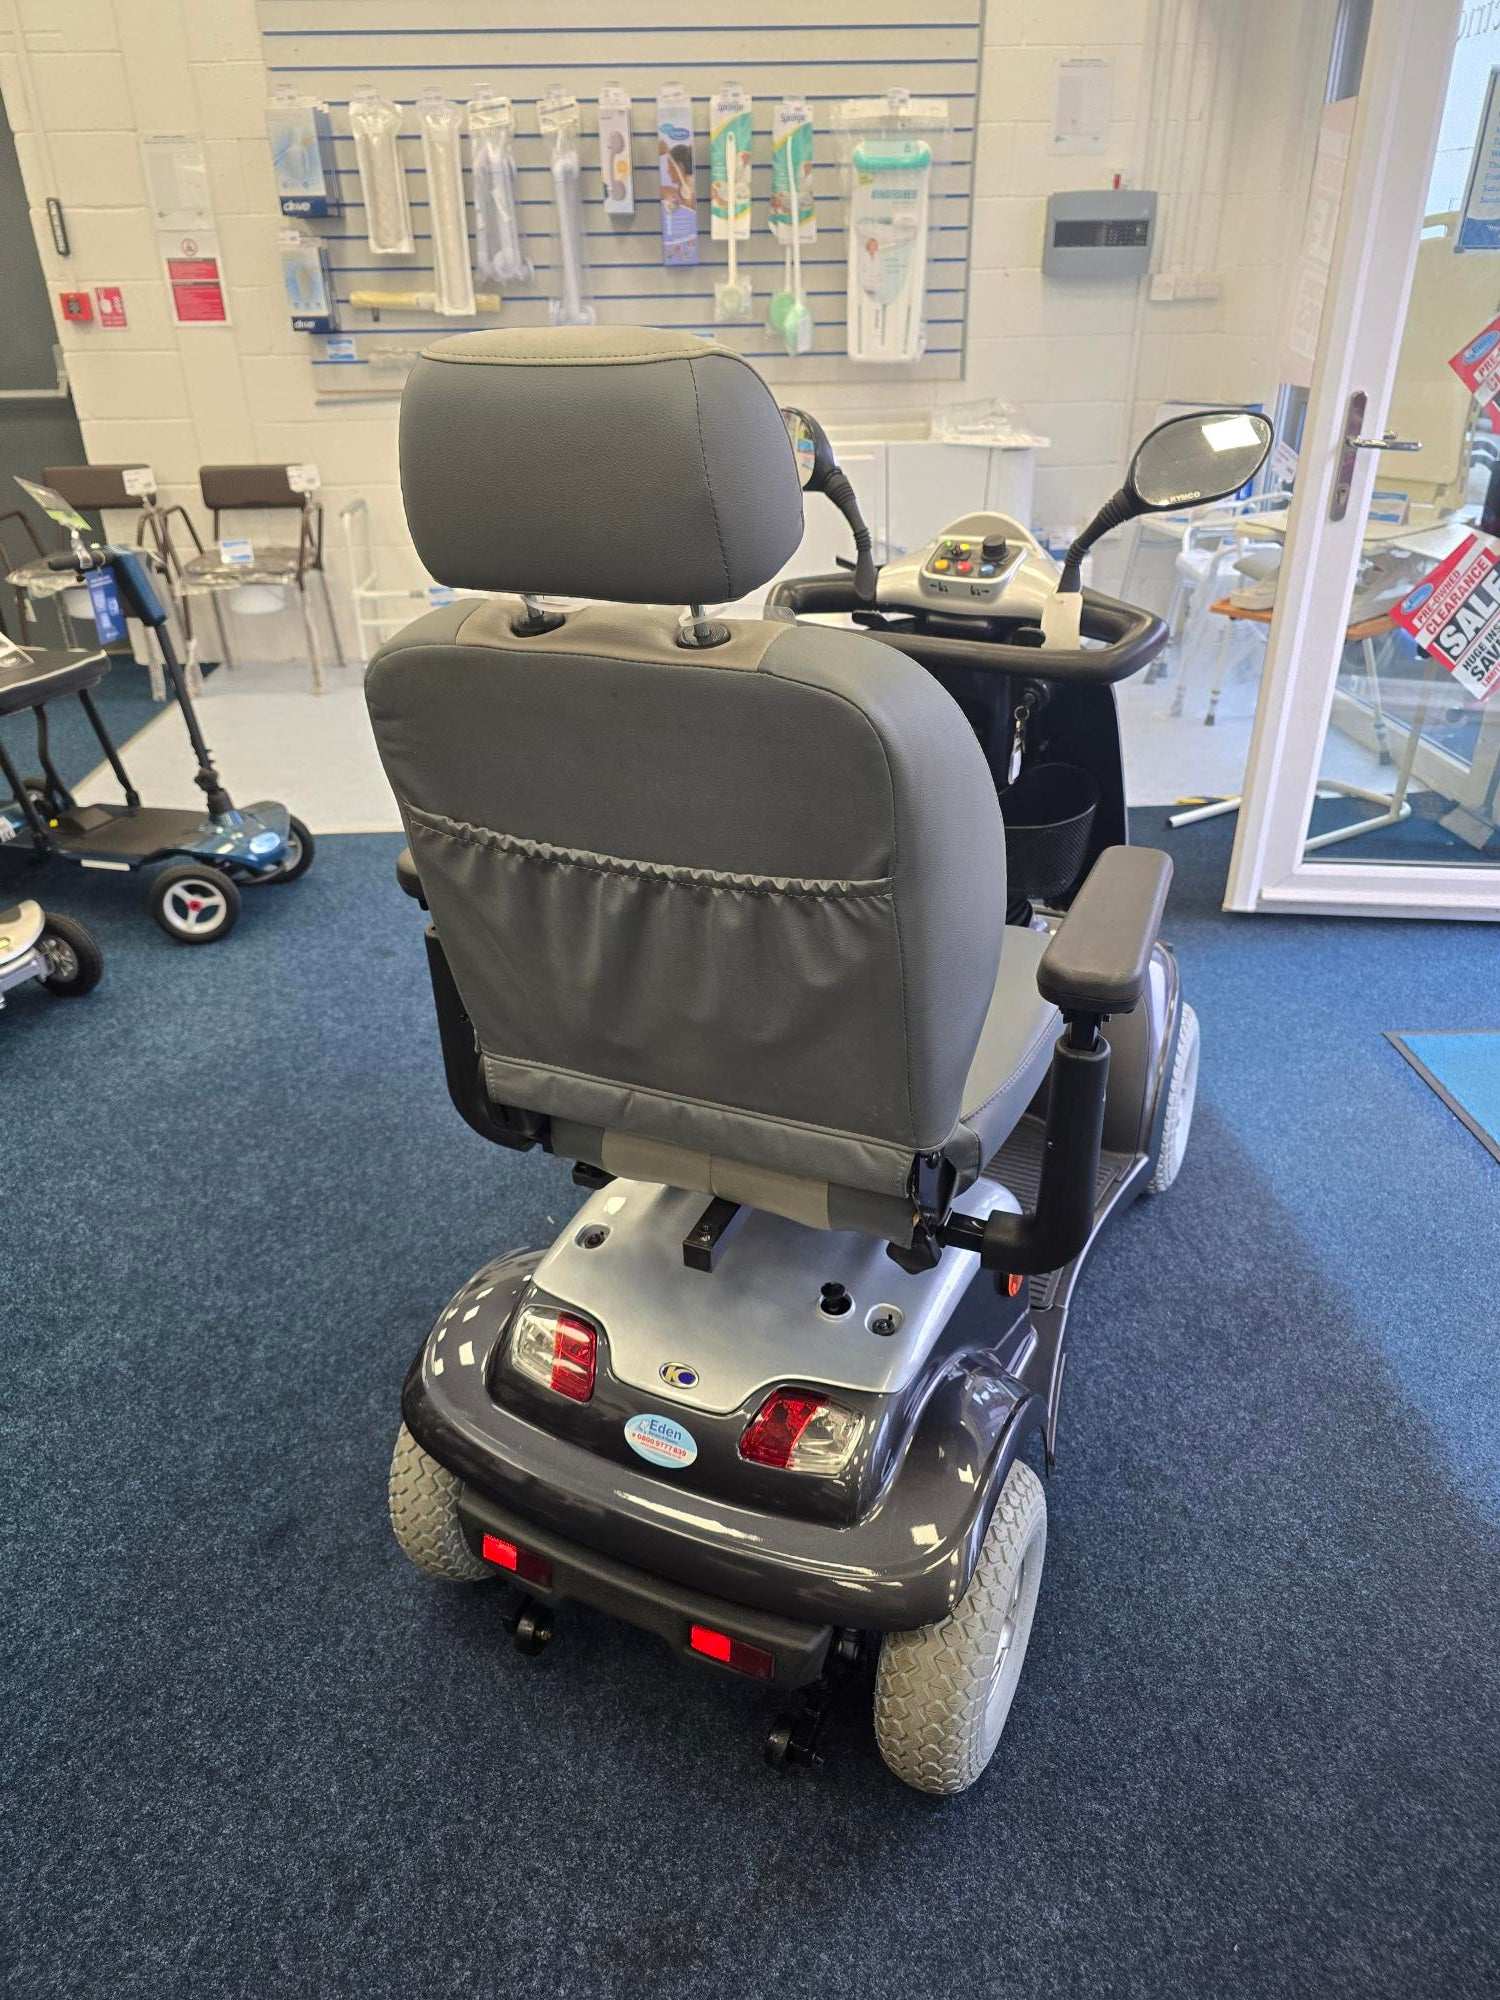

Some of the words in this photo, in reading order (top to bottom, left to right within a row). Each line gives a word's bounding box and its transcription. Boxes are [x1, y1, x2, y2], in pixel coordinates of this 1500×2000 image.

[1417, 570, 1461, 624] PRE-OWNED
[1425, 558, 1489, 636] CLEARANCE
[1462, 642, 1488, 671] HUGE
[636, 1433, 655, 1446] 0800
[648, 1419, 682, 1441] Eden
